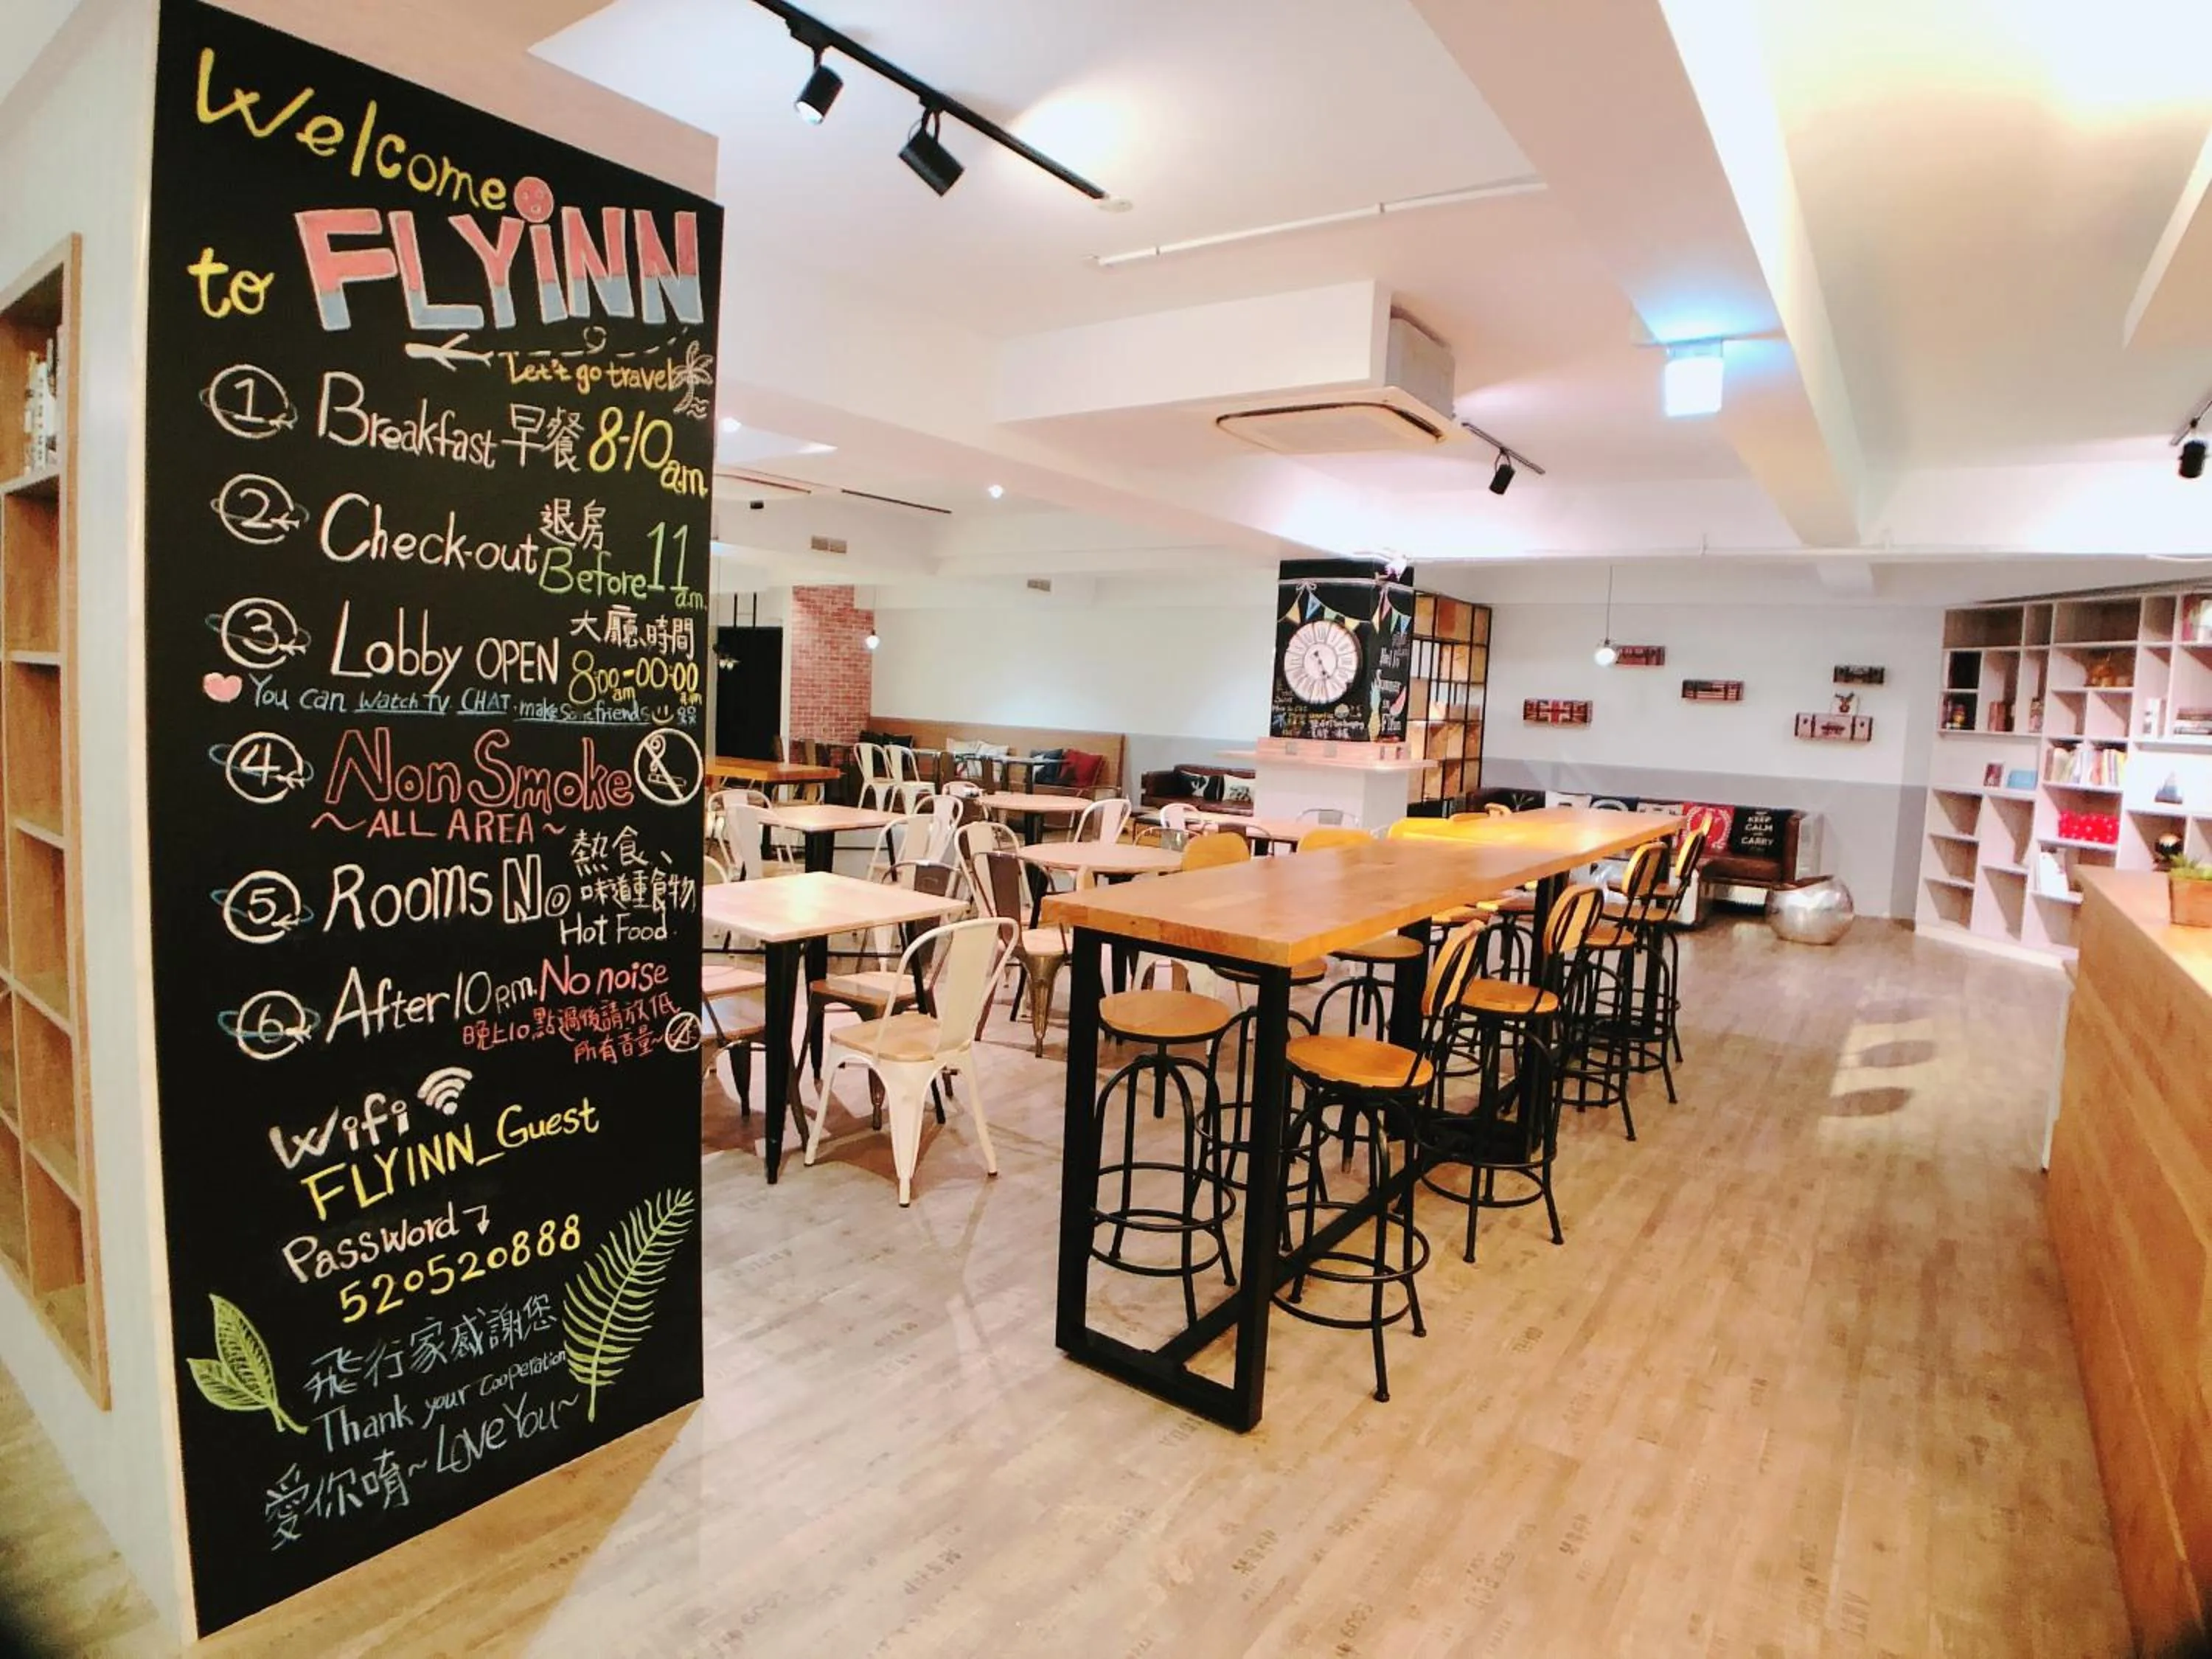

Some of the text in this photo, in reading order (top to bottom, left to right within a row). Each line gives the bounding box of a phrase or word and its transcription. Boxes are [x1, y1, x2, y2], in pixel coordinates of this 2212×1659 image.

[195, 47, 507, 211] Welcome
[187, 246, 274, 319] to
[576, 364, 602, 395] go
[605, 357, 673, 392] travel
[317, 370, 498, 470] Breakfast
[501, 403, 585, 473] 早餐
[320, 492, 540, 577] Check-out
[538, 497, 608, 552] 退房
[538, 546, 647, 600] Before
[646, 521, 690, 591] 11
[330, 599, 465, 695] Lobby
[475, 636, 560, 686] OPEN
[247, 672, 289, 711] You
[461, 686, 512, 712] CHAT
[594, 698, 652, 724] friends
[324, 726, 462, 804] Non
[467, 728, 636, 815] Smoke
[366, 808, 535, 845] ALL AREA
[321, 863, 494, 933] Rooms
[580, 866, 698, 914] 味道重食物
[559, 911, 609, 947] Hot
[324, 966, 451, 1045] After
[538, 954, 591, 1003] No
[596, 960, 671, 995] noise
[339, 1214, 582, 1324] 520520888
[302, 1293, 558, 1405] 飛行家感謝您
[311, 1394, 415, 1453] Thank
[420, 1384, 472, 1430] your
[501, 1391, 560, 1439] You
